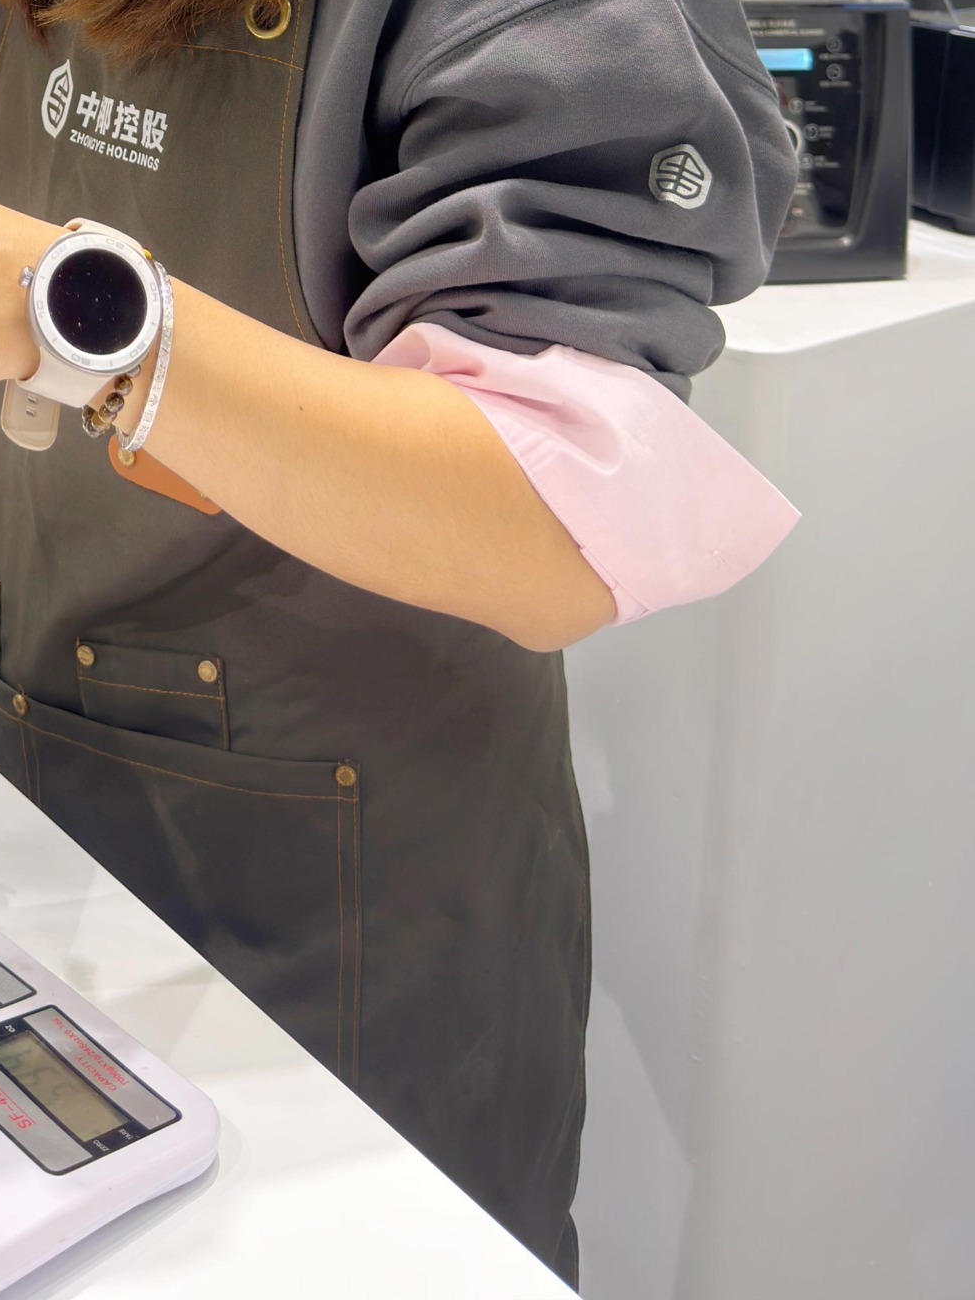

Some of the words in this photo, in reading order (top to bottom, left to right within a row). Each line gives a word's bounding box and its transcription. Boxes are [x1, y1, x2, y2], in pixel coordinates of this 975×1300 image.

[69, 129, 105, 155] ZHONGYE
[106, 143, 160, 172] HOLDINGS
[118, 1127, 135, 1141] TARE
[92, 1138, 111, 1153] ZERO
